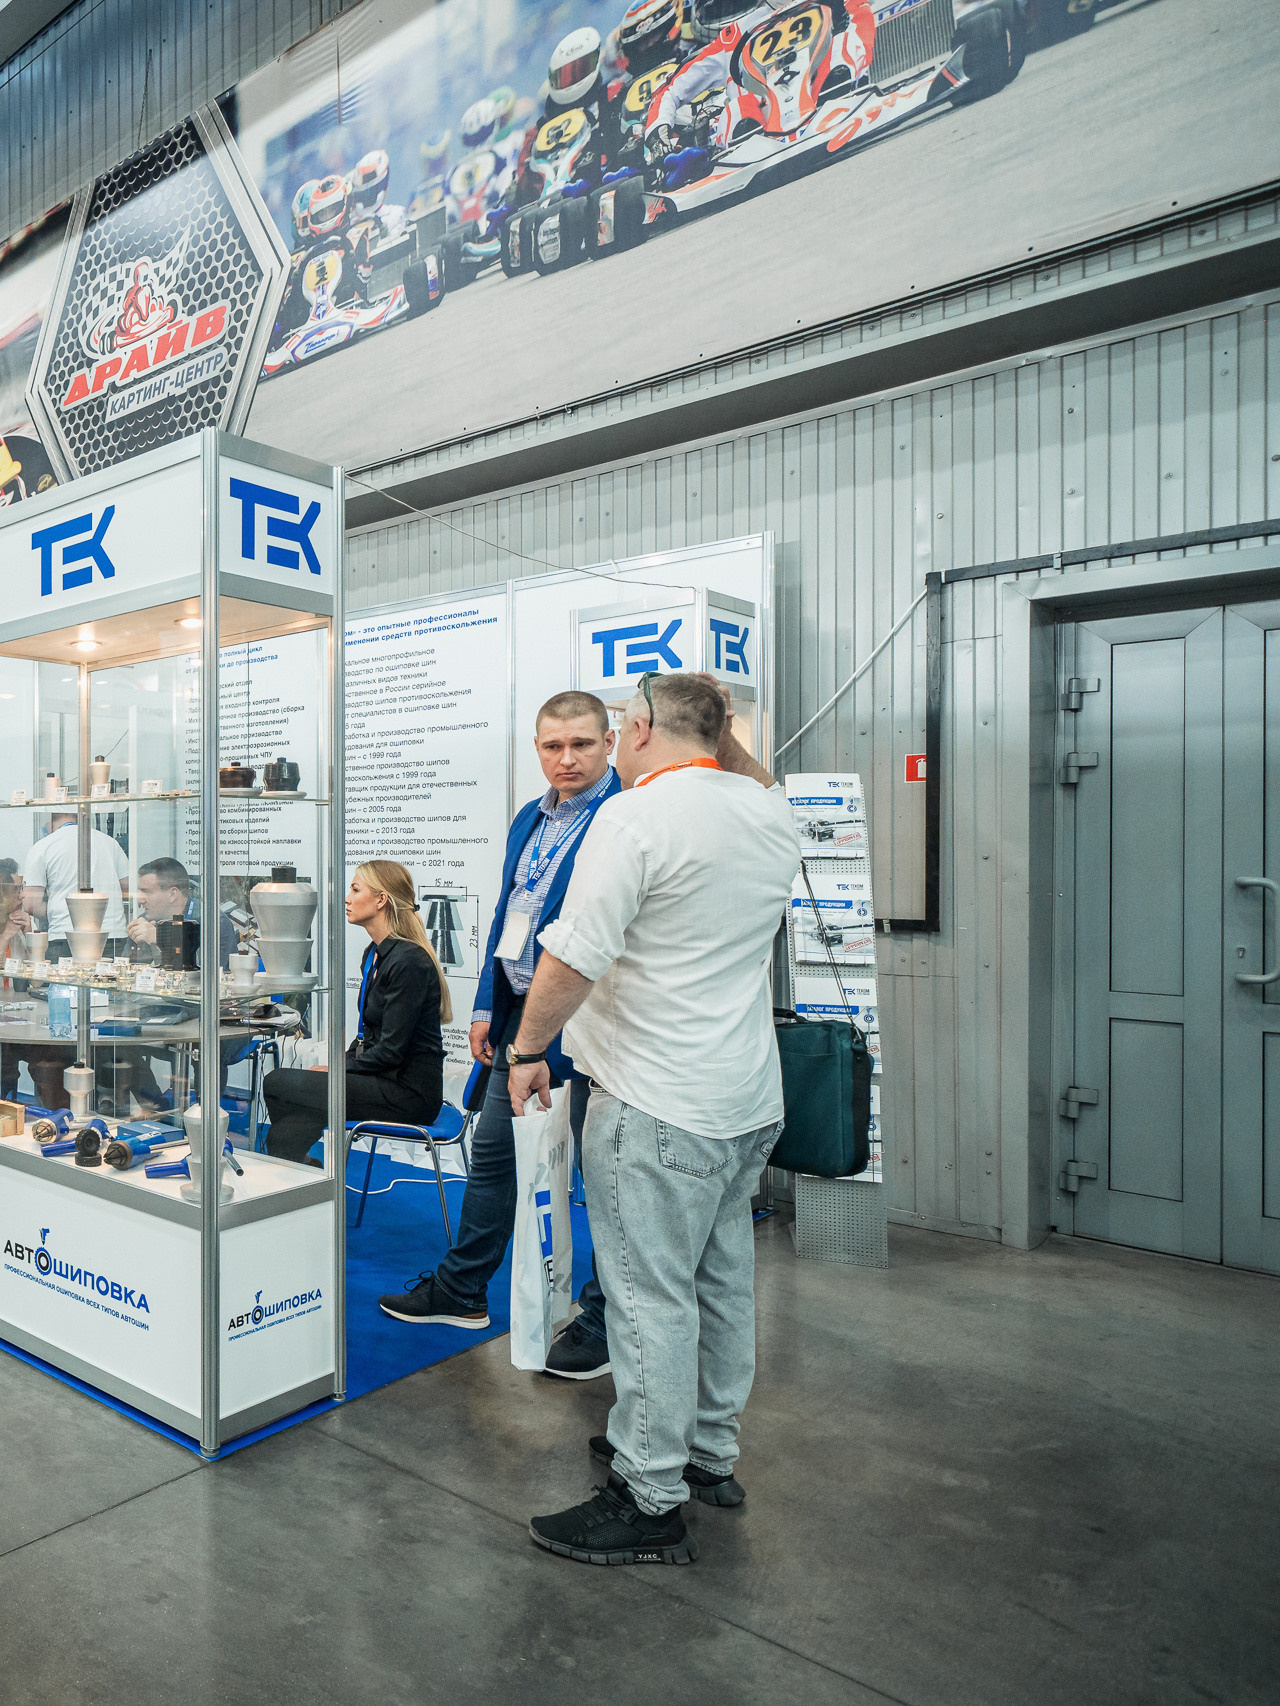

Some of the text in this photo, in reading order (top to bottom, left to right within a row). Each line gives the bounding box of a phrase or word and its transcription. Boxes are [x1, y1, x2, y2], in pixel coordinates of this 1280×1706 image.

[759, 16, 813, 63] 23
[63, 305, 227, 406] ДРАЙВ
[110, 352, 224, 416] КАРТИНГ-ЦЕНТР
[377, 621, 411, 632] опытные
[413, 609, 479, 625] профессионалы
[345, 617, 498, 647] именении средств противоскольжения
[224, 646, 263, 657] полный цикл
[345, 648, 435, 666] альное многопрофильное
[236, 654, 278, 666] производства
[345, 668, 374, 677] зводство
[385, 661, 420, 671] ошиповке
[421, 659, 437, 667] шин
[345, 672, 428, 687] азличных видов техники
[345, 688, 378, 698] нственное
[385, 685, 410, 694] России
[412, 680, 446, 691] серийное
[252, 697, 280, 706] контроля
[345, 699, 374, 709] зводство
[398, 689, 472, 703] противоскольжения
[238, 705, 305, 718] производство (сборка
[351, 709, 396, 719] специалистов
[404, 704, 440, 713] ошиповке
[246, 718, 289, 728] изготовления)
[240, 730, 282, 739] производство
[345, 732, 370, 740] работка
[377, 727, 425, 738] производство
[427, 721, 489, 734] промышленного
[231, 741, 290, 751] электроэрозионных
[345, 743, 374, 751] удования
[390, 738, 424, 747] ошиповки
[369, 752, 384, 760] 1999
[376, 760, 424, 770] производство
[402, 771, 419, 779] 1999
[370, 783, 406, 792] продукции
[422, 780, 478, 789] отечественных
[376, 793, 431, 802] производителей
[345, 817, 370, 825] работка
[377, 816, 426, 824] производство
[345, 838, 370, 846] работка
[377, 838, 426, 846] производство
[427, 837, 489, 845] промышленного
[345, 849, 374, 857] удования
[4, 1239, 150, 1314] АВТОШИПОВКА
[4, 1263, 149, 1331] ПРОФЕССИОНАЛЬНАЯ ОШИПОВКА ВСЕХ ТИПОВ АВТОШИН
[228, 1288, 322, 1331] АВТОШИПОВКА
